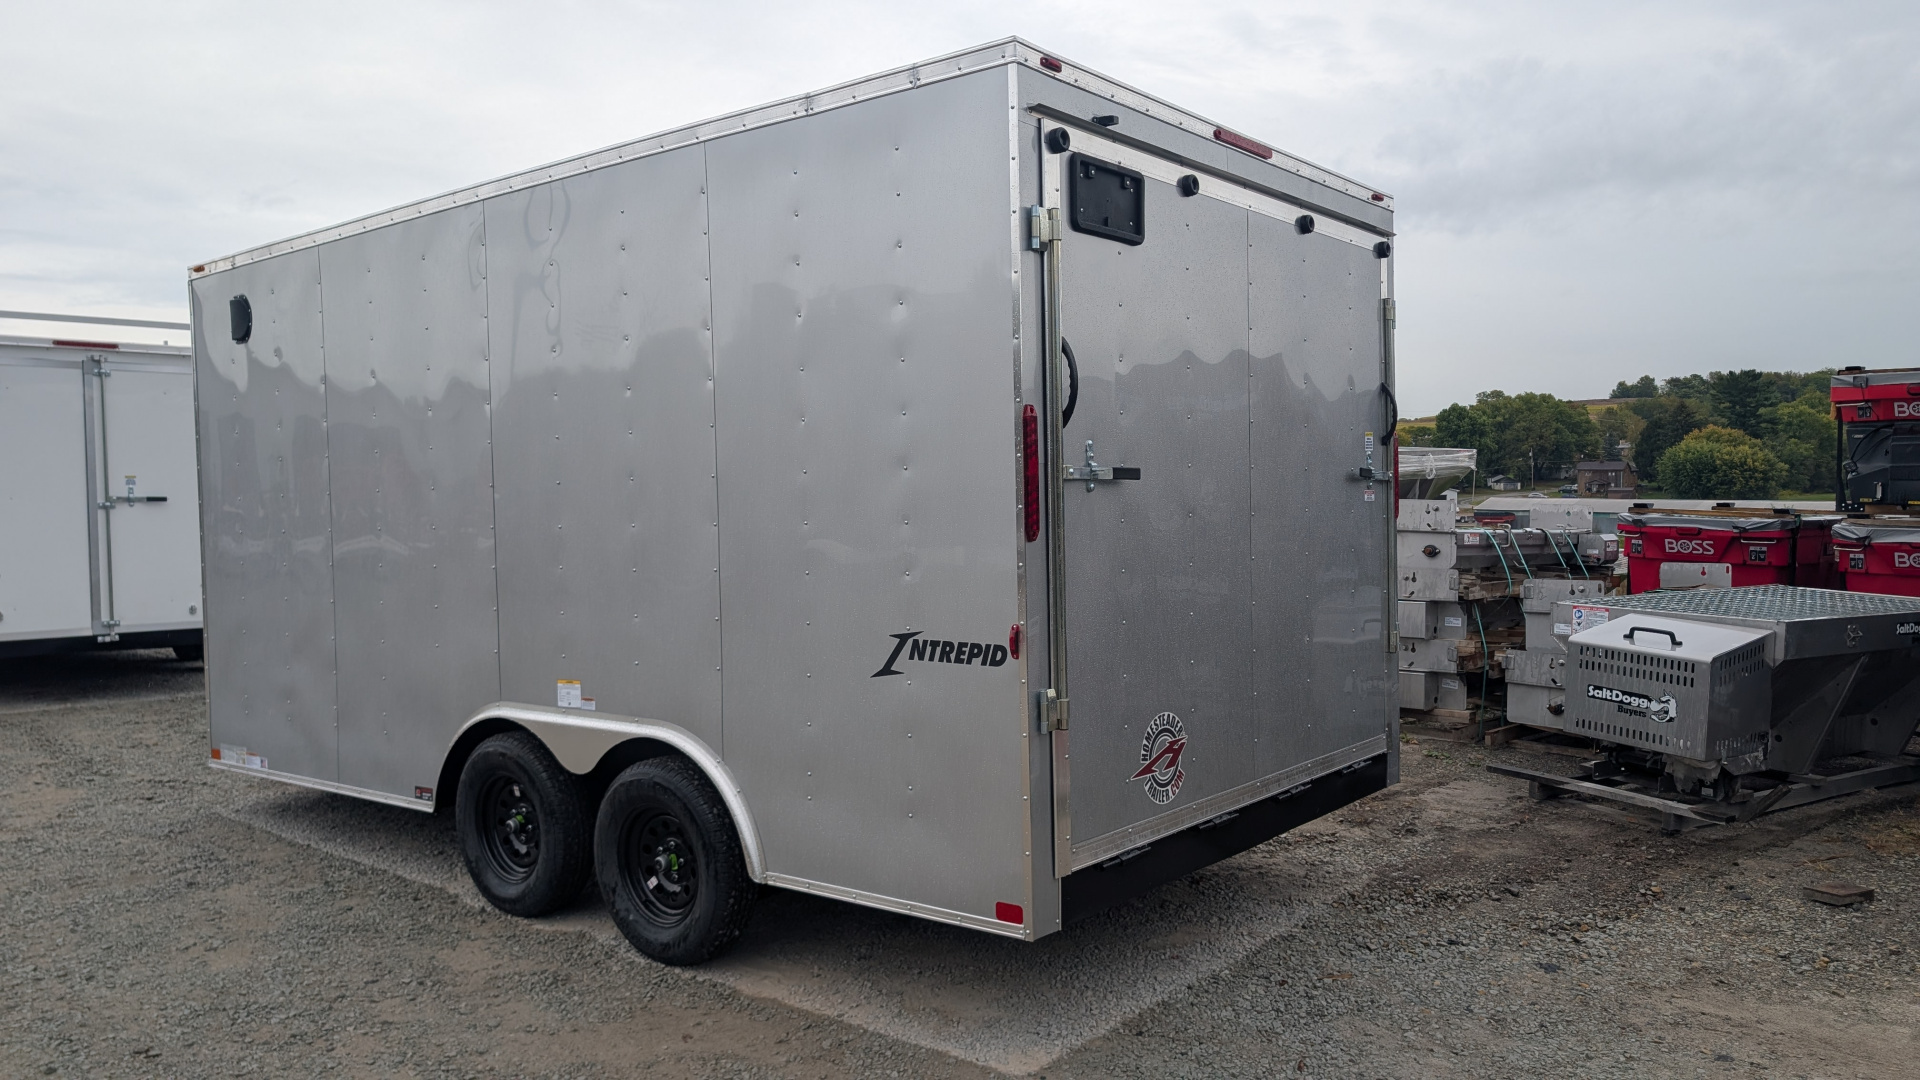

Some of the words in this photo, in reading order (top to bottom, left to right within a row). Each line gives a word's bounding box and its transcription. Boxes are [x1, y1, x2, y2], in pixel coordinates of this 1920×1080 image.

[1664, 538, 1715, 555] BOSS
[1896, 622, 1920, 635] SaltDo
[870, 631, 1008, 678] INTREPID
[1587, 685, 1649, 709] SaltDogg
[1617, 705, 1647, 718] Buyers
[1141, 713, 1184, 762] HOMESTEADER
